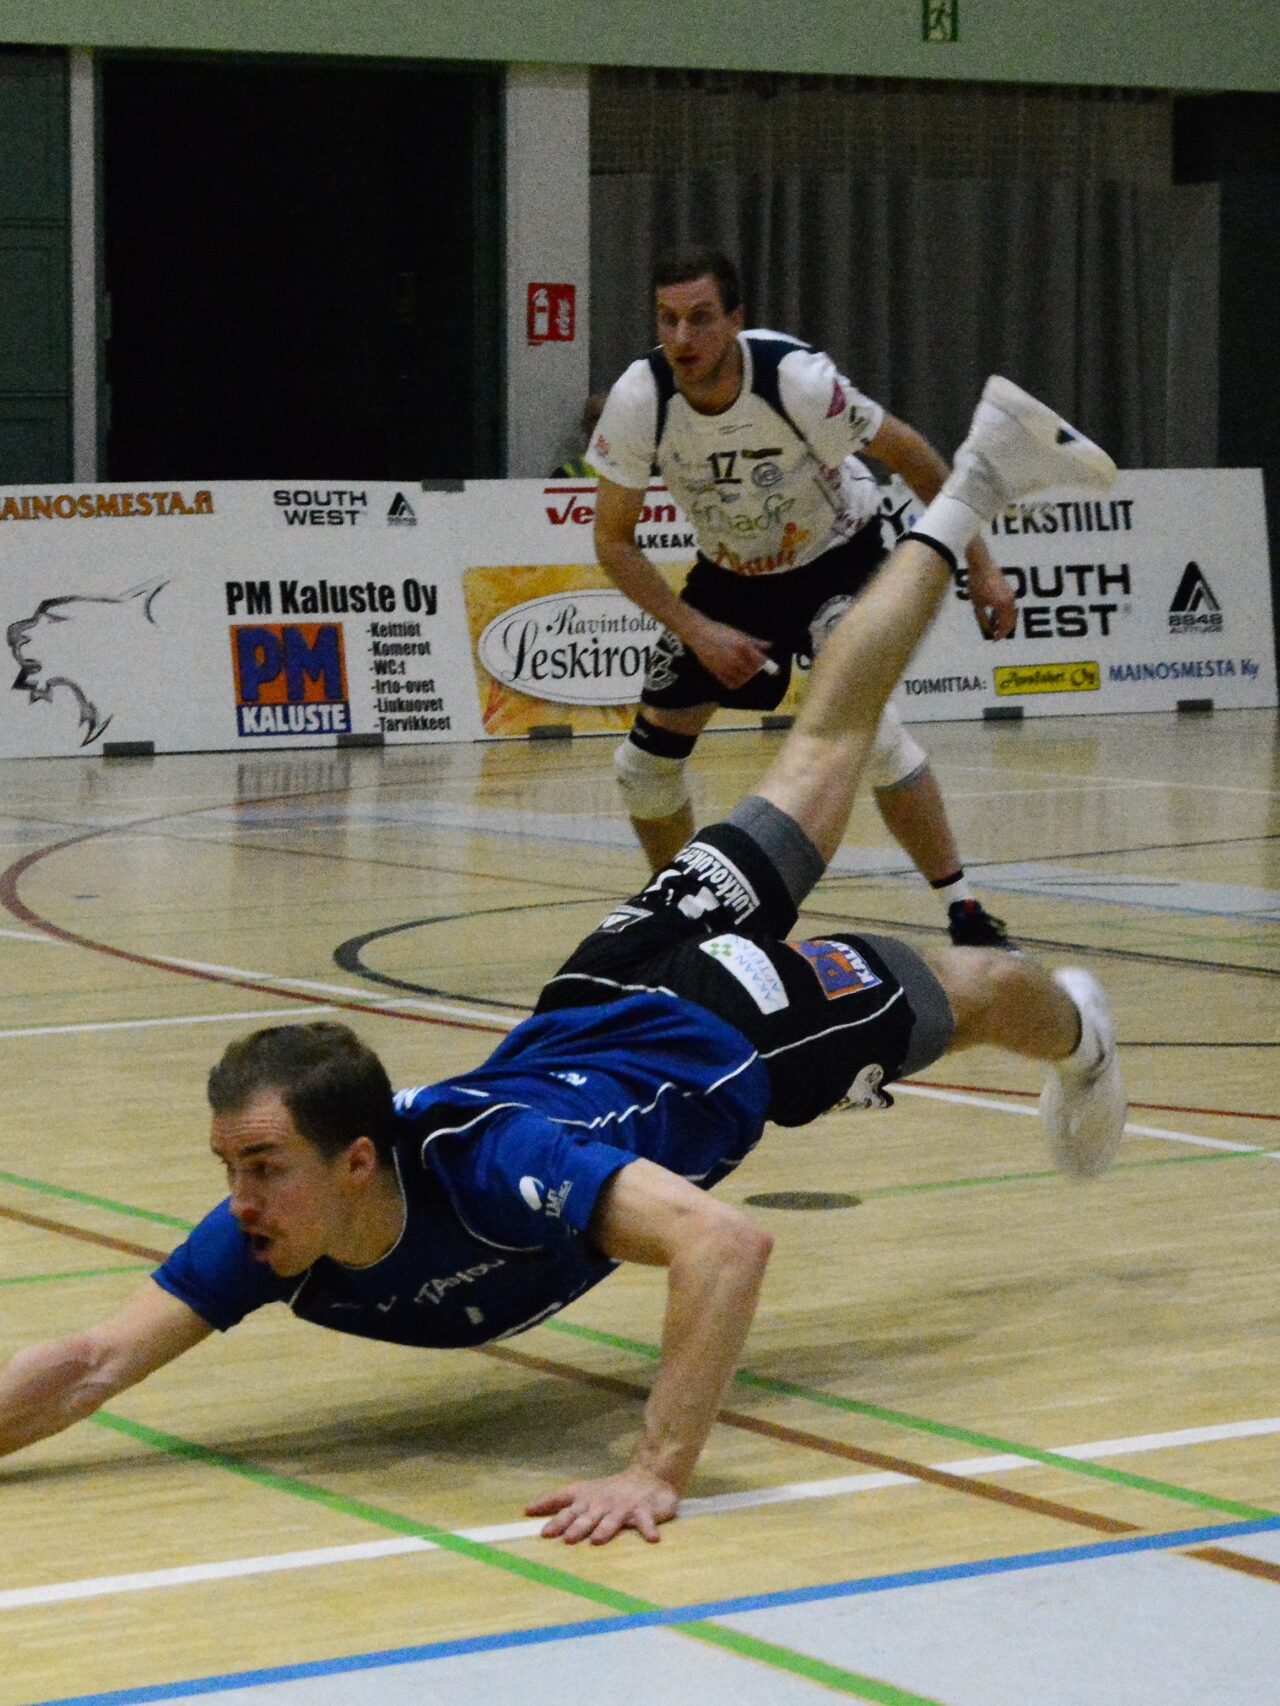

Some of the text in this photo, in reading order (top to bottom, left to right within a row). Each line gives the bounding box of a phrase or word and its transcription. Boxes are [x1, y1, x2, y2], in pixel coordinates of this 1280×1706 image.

[707, 450, 738, 479] 17
[273, 490, 367, 506] SOUTH
[284, 510, 360, 525] WEST
[226, 578, 438, 616] PM Kaluste Oy
[554, 604, 658, 635] Ravintola
[237, 626, 344, 704] PM
[1109, 659, 1236, 681] MAINOSMESTA
[242, 704, 348, 733] KALUSTE
